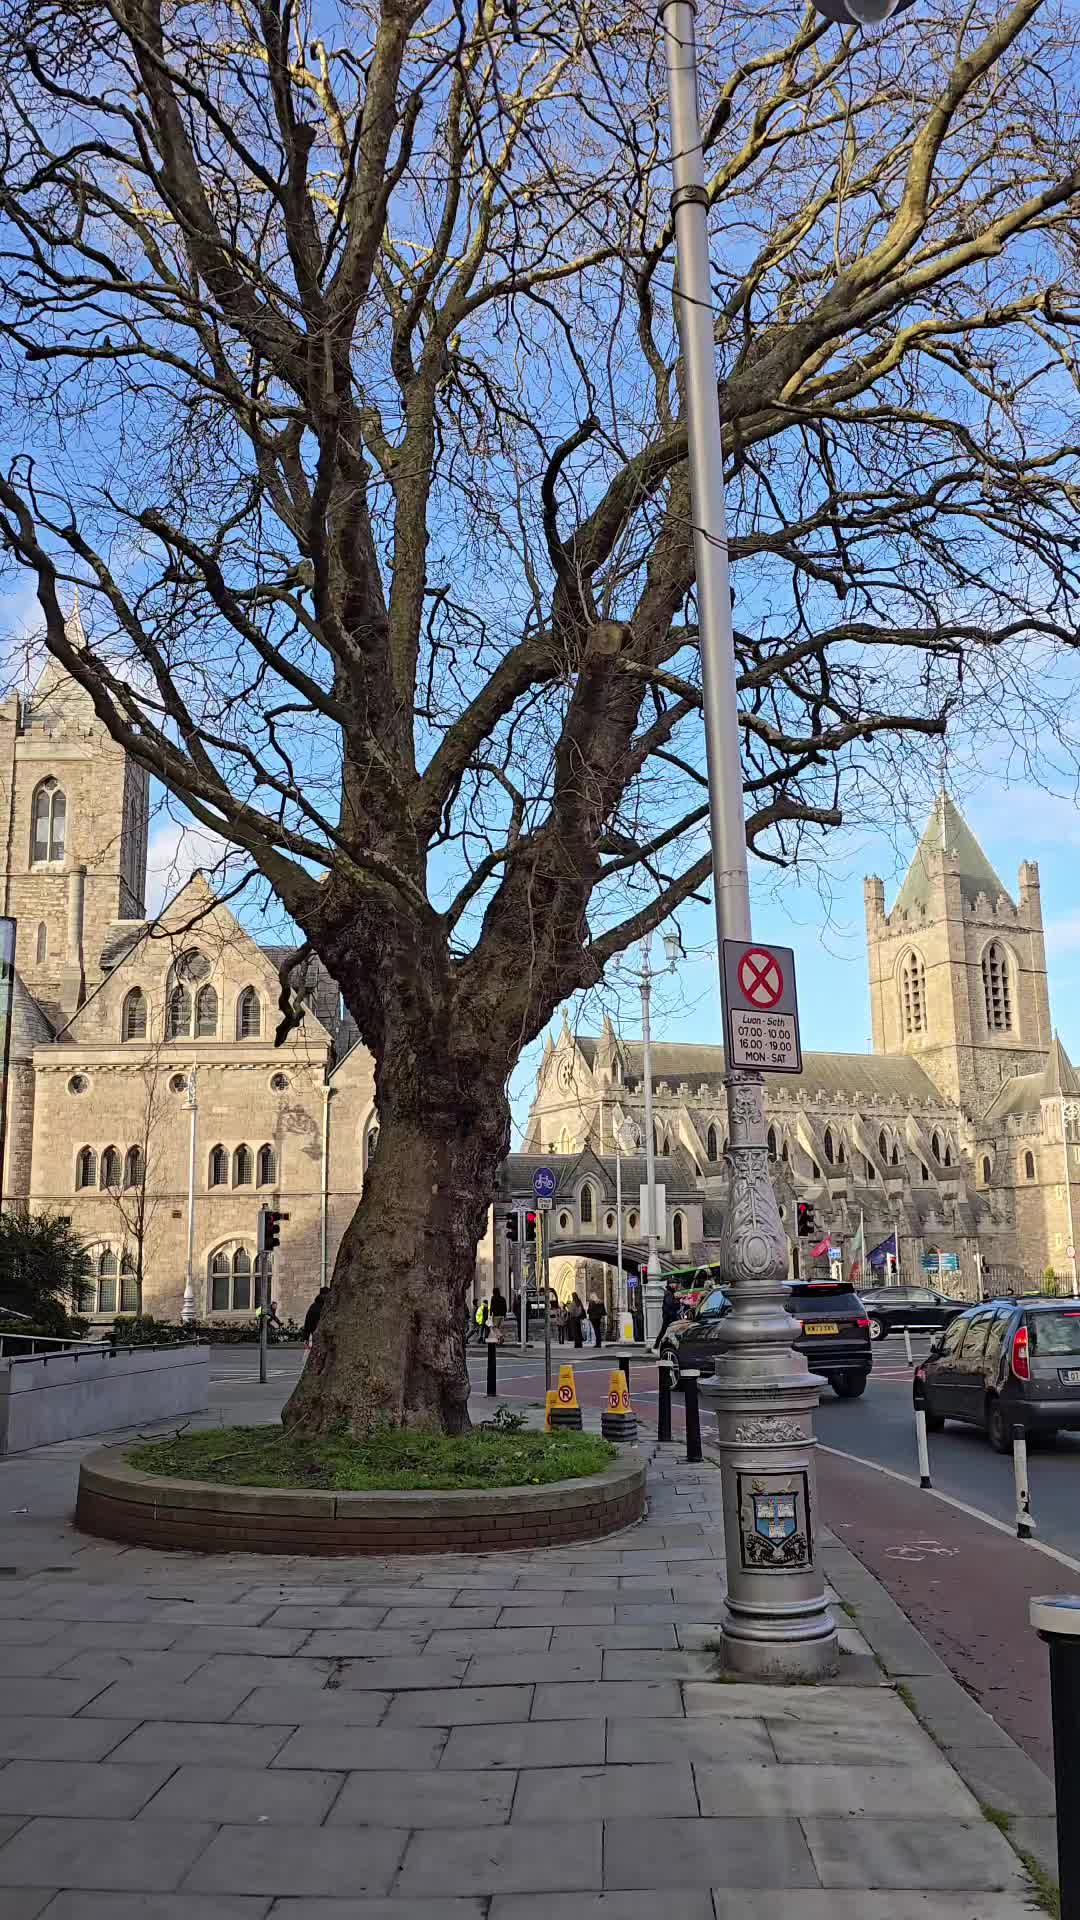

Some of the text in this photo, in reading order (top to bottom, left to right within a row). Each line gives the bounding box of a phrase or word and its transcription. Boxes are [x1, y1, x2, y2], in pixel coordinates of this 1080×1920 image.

[738, 1026, 763, 1037] 07.00
[768, 1029, 791, 1039] 10.00
[740, 1038, 763, 1049] 16.00
[769, 1041, 792, 1051] 19.00
[745, 1051, 766, 1062] MON
[771, 1053, 786, 1063] SAT
